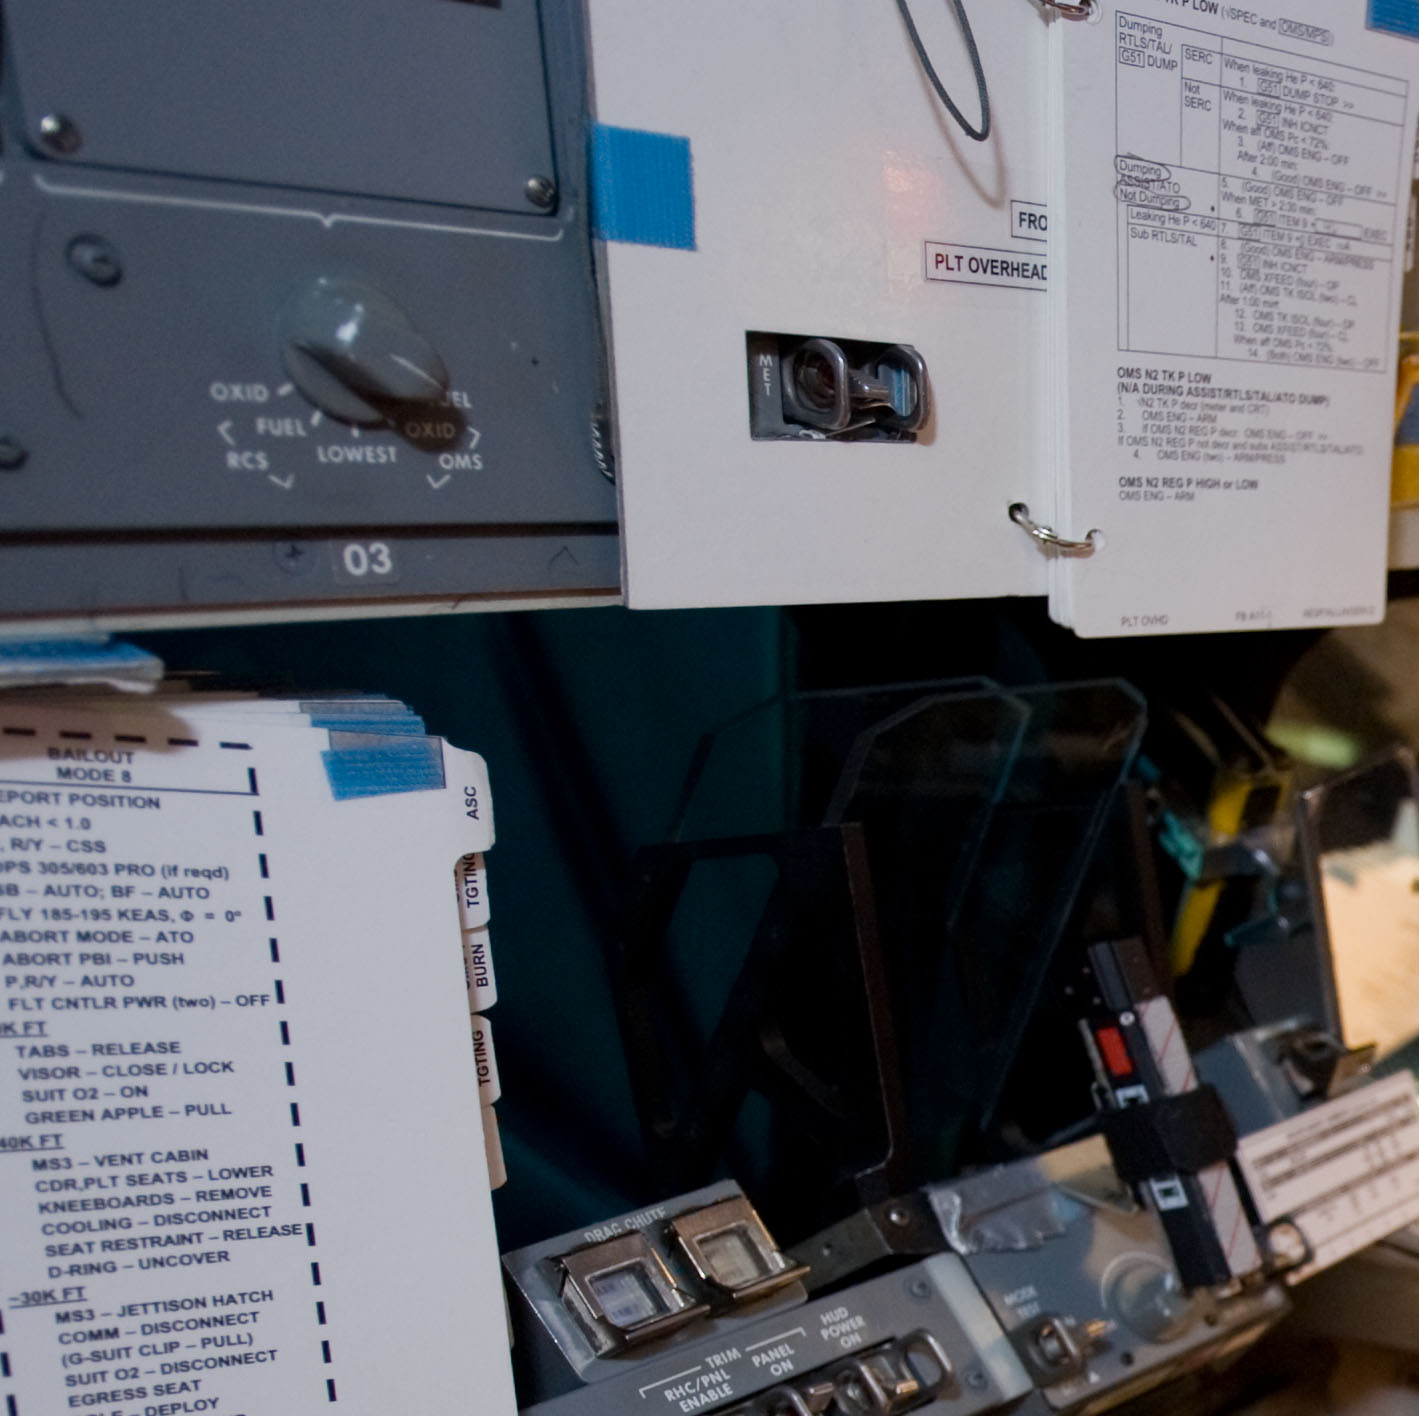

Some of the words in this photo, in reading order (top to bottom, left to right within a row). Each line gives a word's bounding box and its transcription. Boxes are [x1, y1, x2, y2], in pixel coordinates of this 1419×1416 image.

[1119, 15, 1163, 39] Dumping
[1121, 50, 1142, 64] G51
[1148, 55, 1178, 71] DUMP
[1185, 48, 1213, 65] SERC
[1184, 82, 1200, 95] Not
[1184, 95, 1212, 112] SERC
[1119, 160, 1162, 179] Dumping
[1120, 189, 1136, 201] Not
[1139, 191, 1180, 211] Dumping
[1018, 211, 1047, 231] FRO
[1130, 209, 1165, 226] Leaking
[1168, 213, 1182, 225] He
[1130, 227, 1149, 240] Sub
[1152, 230, 1198, 247] RTLS/TAL
[935, 253, 963, 272] PLT
[1117, 367, 1142, 379] OMS
[1162, 369, 1176, 381] TK
[1188, 371, 1212, 384] LOW
[210, 382, 269, 402] OXID
[1142, 383, 1184, 397] DURING
[256, 417, 307, 437] FUEL
[404, 421, 456, 439] OXID
[226, 451, 269, 471] RCS
[317, 446, 396, 464] LOWEST
[438, 453, 483, 470] OMS
[1118, 477, 1143, 488] OMS
[1162, 477, 1184, 489] REG
[343, 542, 392, 576] 03
[48, 748, 134, 764] BAILOUT
[56, 767, 115, 782] MODE
[121, 770, 132, 783] 8
[68, 793, 160, 809] POSITION
[464, 785, 480, 820] ASC
[65, 817, 91, 830] 1.0
[10, 837, 42, 851] R/Y
[66, 839, 106, 853] CSS
[0, 860, 31, 874] PS
[38, 861, 108, 876] 305/603
[114, 863, 155, 877] PRO
[161, 864, 178, 880] (if
[184, 866, 230, 881] reqd)
[43, 884, 105, 900] AUTO;
[111, 885, 135, 898] BF
[158, 887, 210, 900] AUTO
[41, 908, 112, 921] 185-195
[117, 909, 176, 923] KEAS,
[1, 930, 69, 943] ABORT
[76, 930, 134, 943] MODE
[155, 931, 195, 944] ATO
[3, 953, 72, 966] ABORT
[79, 953, 111, 966] PBI
[132, 952, 185, 965] PUSH
[472, 944, 489, 987] BURN
[80, 974, 135, 988] AUTO
[8, 997, 44, 1011] FLT
[51, 996, 118, 1010] CNTLR
[123, 996, 167, 1009] PWR
[172, 994, 216, 1011] (two)
[235, 994, 270, 1007] OFF
[23, 1021, 47, 1036] FT
[15, 1045, 70, 1058] TABS
[91, 1041, 181, 1056] RELEASE
[472, 1030, 491, 1086] TGTING
[17, 1066, 81, 1081] VISOR
[102, 1063, 167, 1078] CLOSE
[183, 1061, 234, 1075] LOCK
[22, 1088, 66, 1103] SUIT
[72, 1088, 99, 1101] O2
[120, 1085, 149, 1098] ON
[25, 1109, 95, 1124] GREEN
[101, 1106, 164, 1121] APPLE
[184, 1103, 232, 1117] PULL
[39, 1134, 63, 1148] FT
[32, 1158, 73, 1171] MS3
[94, 1152, 145, 1168] VENT
[150, 1149, 209, 1164] CABIN
[35, 1175, 119, 1193] CDR,PLT
[125, 1171, 188, 1187] SEATS
[208, 1165, 274, 1181] LOWER
[38, 1193, 176, 1215] KNEEBOARDS
[195, 1185, 273, 1203] REMOVE
[41, 1217, 133, 1236] COOLING
[153, 1205, 272, 1227] DISCONNECT
[45, 1241, 95, 1258] SEAT
[101, 1232, 204, 1253] RESTRAINT
[223, 1223, 303, 1242] RELEASE
[48, 1261, 117, 1279] D-RING
[138, 1250, 231, 1270] UNCOVER
[62, 1286, 86, 1301] FT
[55, 1309, 95, 1324] MS3
[117, 1297, 207, 1318] JETTISON
[212, 1290, 274, 1308] HATCH
[820, 1306, 848, 1325] HUD
[58, 1328, 120, 1345] COMM
[140, 1311, 260, 1336] DISCONNECT
[820, 1316, 866, 1341] POWER
[61, 1346, 133, 1368] (G-SUIT
[138, 1341, 181, 1357] CLIP
[201, 1332, 254, 1350] PULL)
[840, 1334, 862, 1349] ON
[705, 1348, 741, 1369] TRIM
[751, 1344, 794, 1368] PANEL
[65, 1370, 109, 1388] SUIT
[114, 1367, 140, 1382] O2
[160, 1349, 278, 1376] DISCONNECT
[770, 1360, 794, 1377] ON
[68, 1386, 148, 1408] EGRESS
[153, 1379, 202, 1397] SEAT
[664, 1369, 731, 1403] RHC/PNL
[679, 1384, 733, 1413] ENABLE
